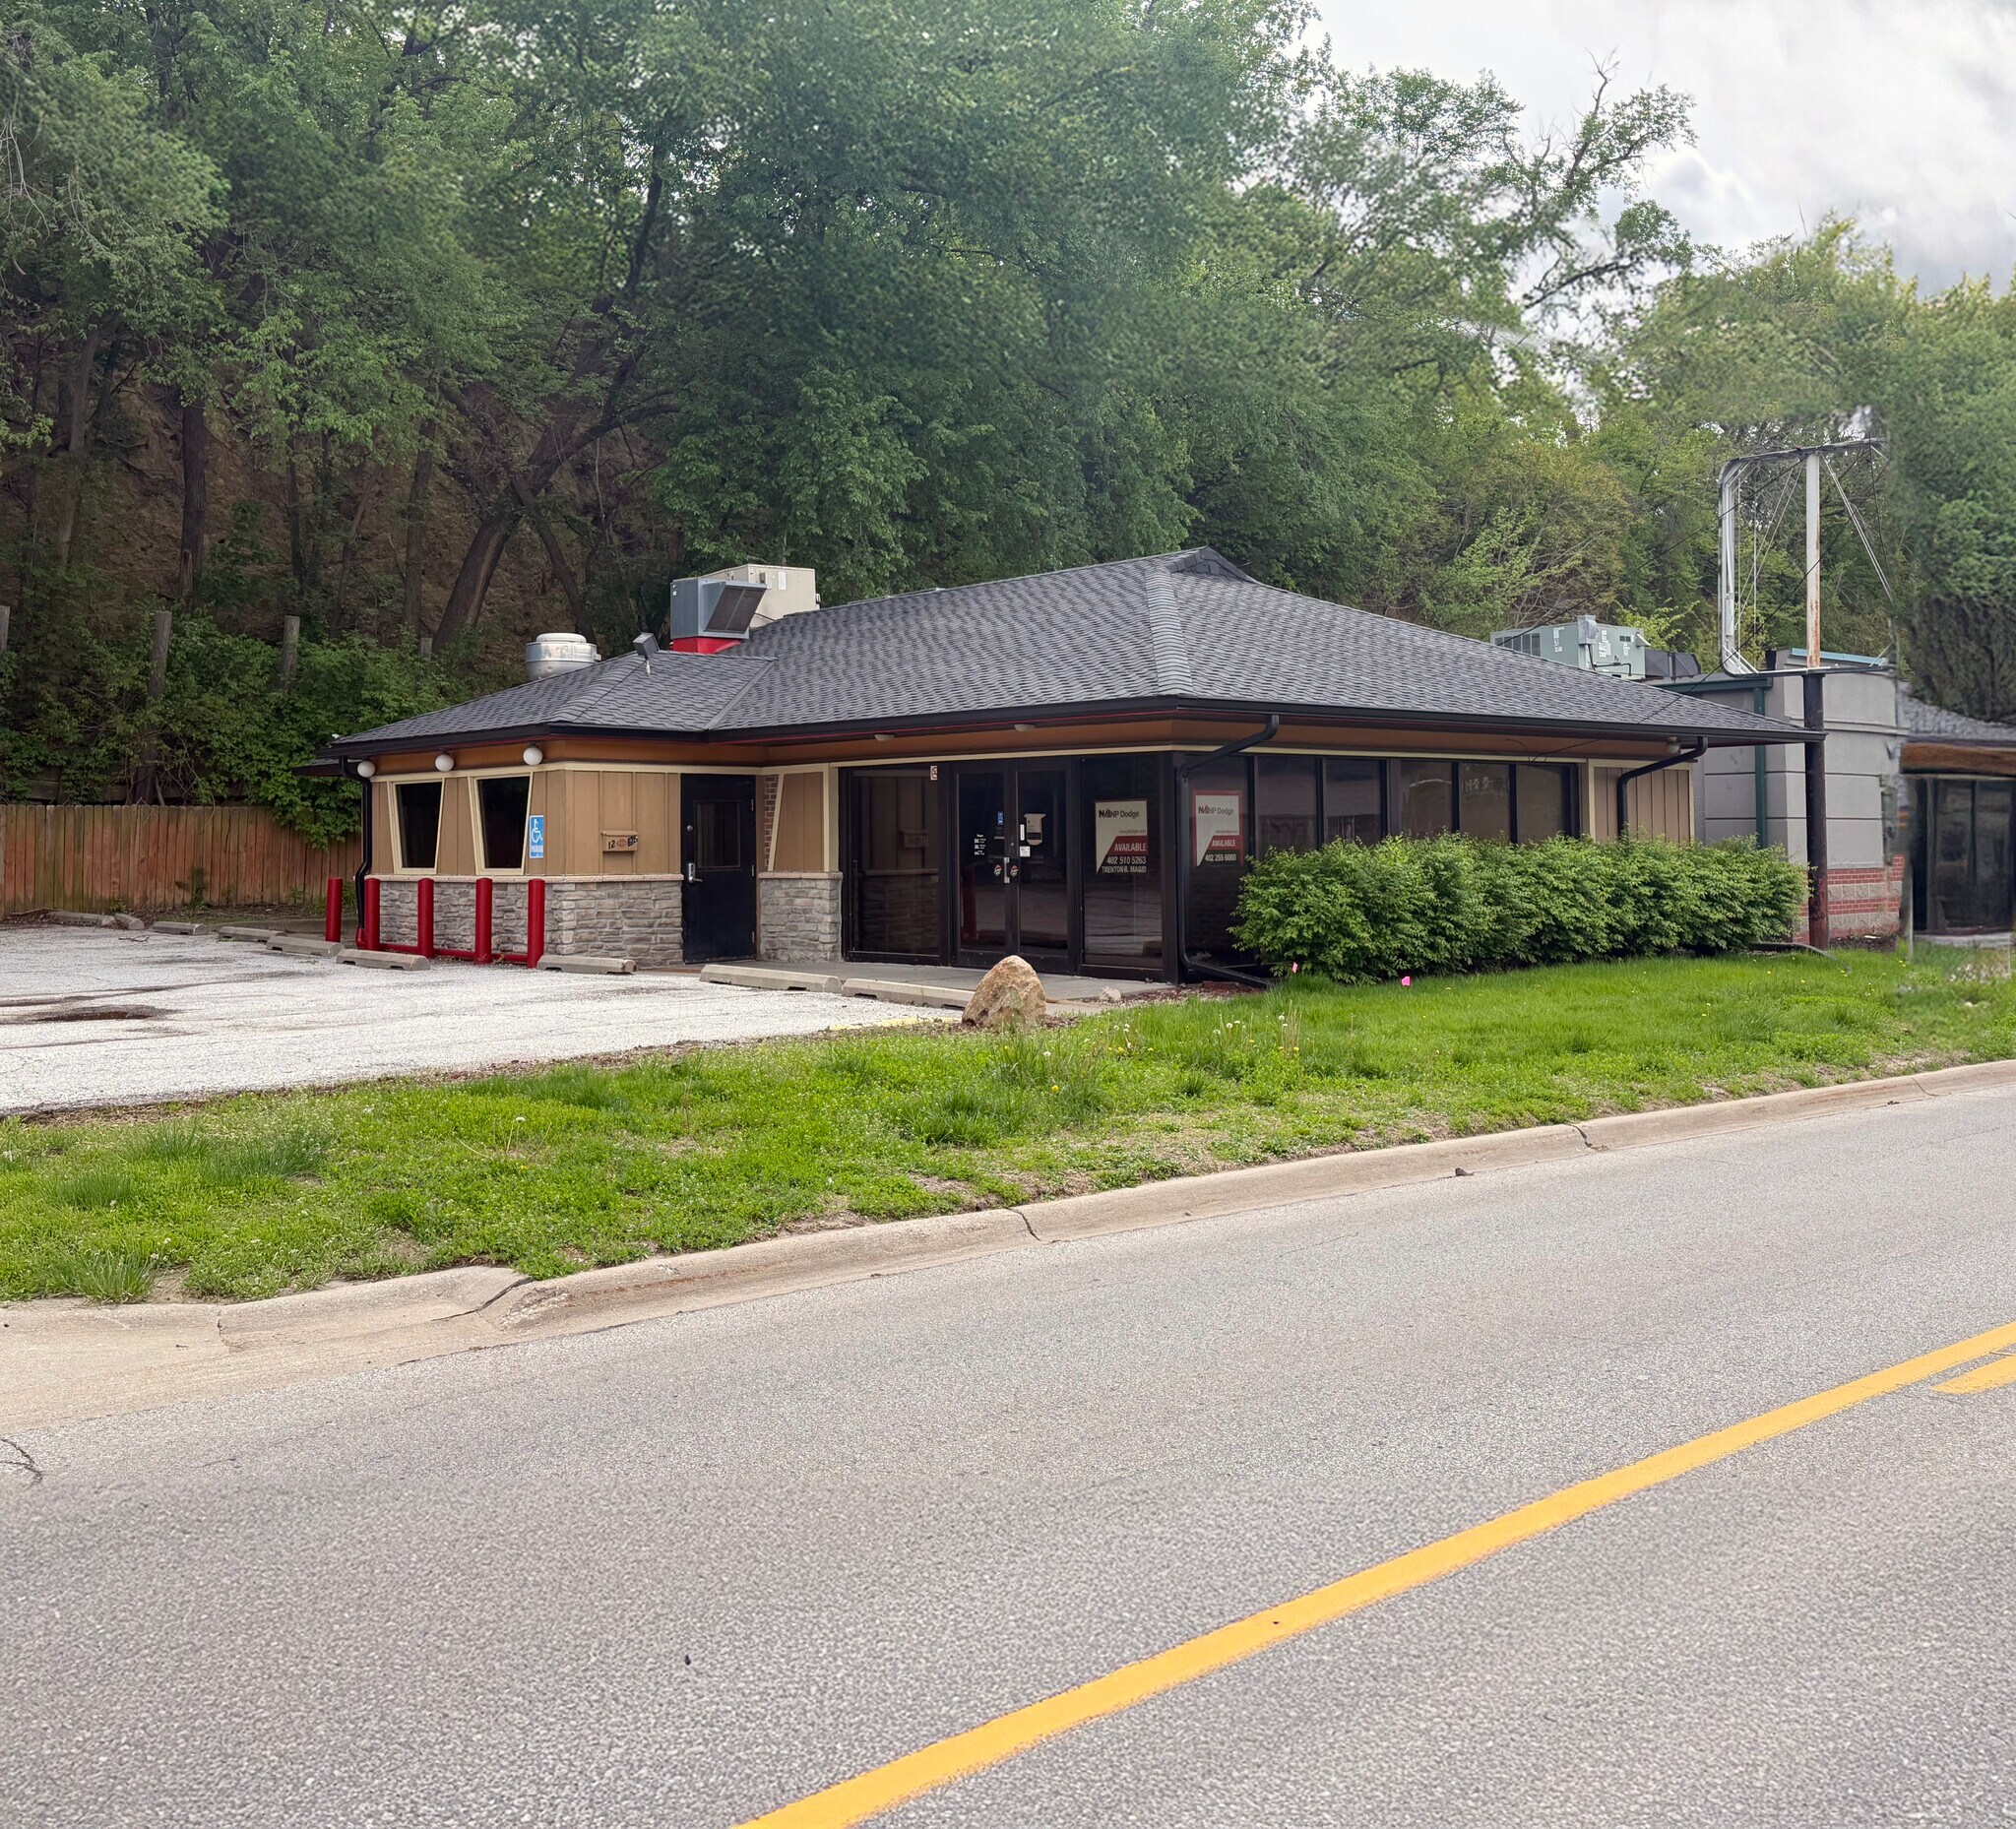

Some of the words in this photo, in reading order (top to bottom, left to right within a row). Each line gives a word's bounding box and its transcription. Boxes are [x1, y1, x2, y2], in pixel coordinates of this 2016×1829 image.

[1120, 809, 1140, 819] Dodge
[1217, 807, 1234, 816] Dodge
[1113, 843, 1147, 851] AVAILABLE
[1211, 839, 1236, 848] AVAILABLE
[1119, 855, 1131, 864] 510
[1131, 855, 1147, 864] 5263
